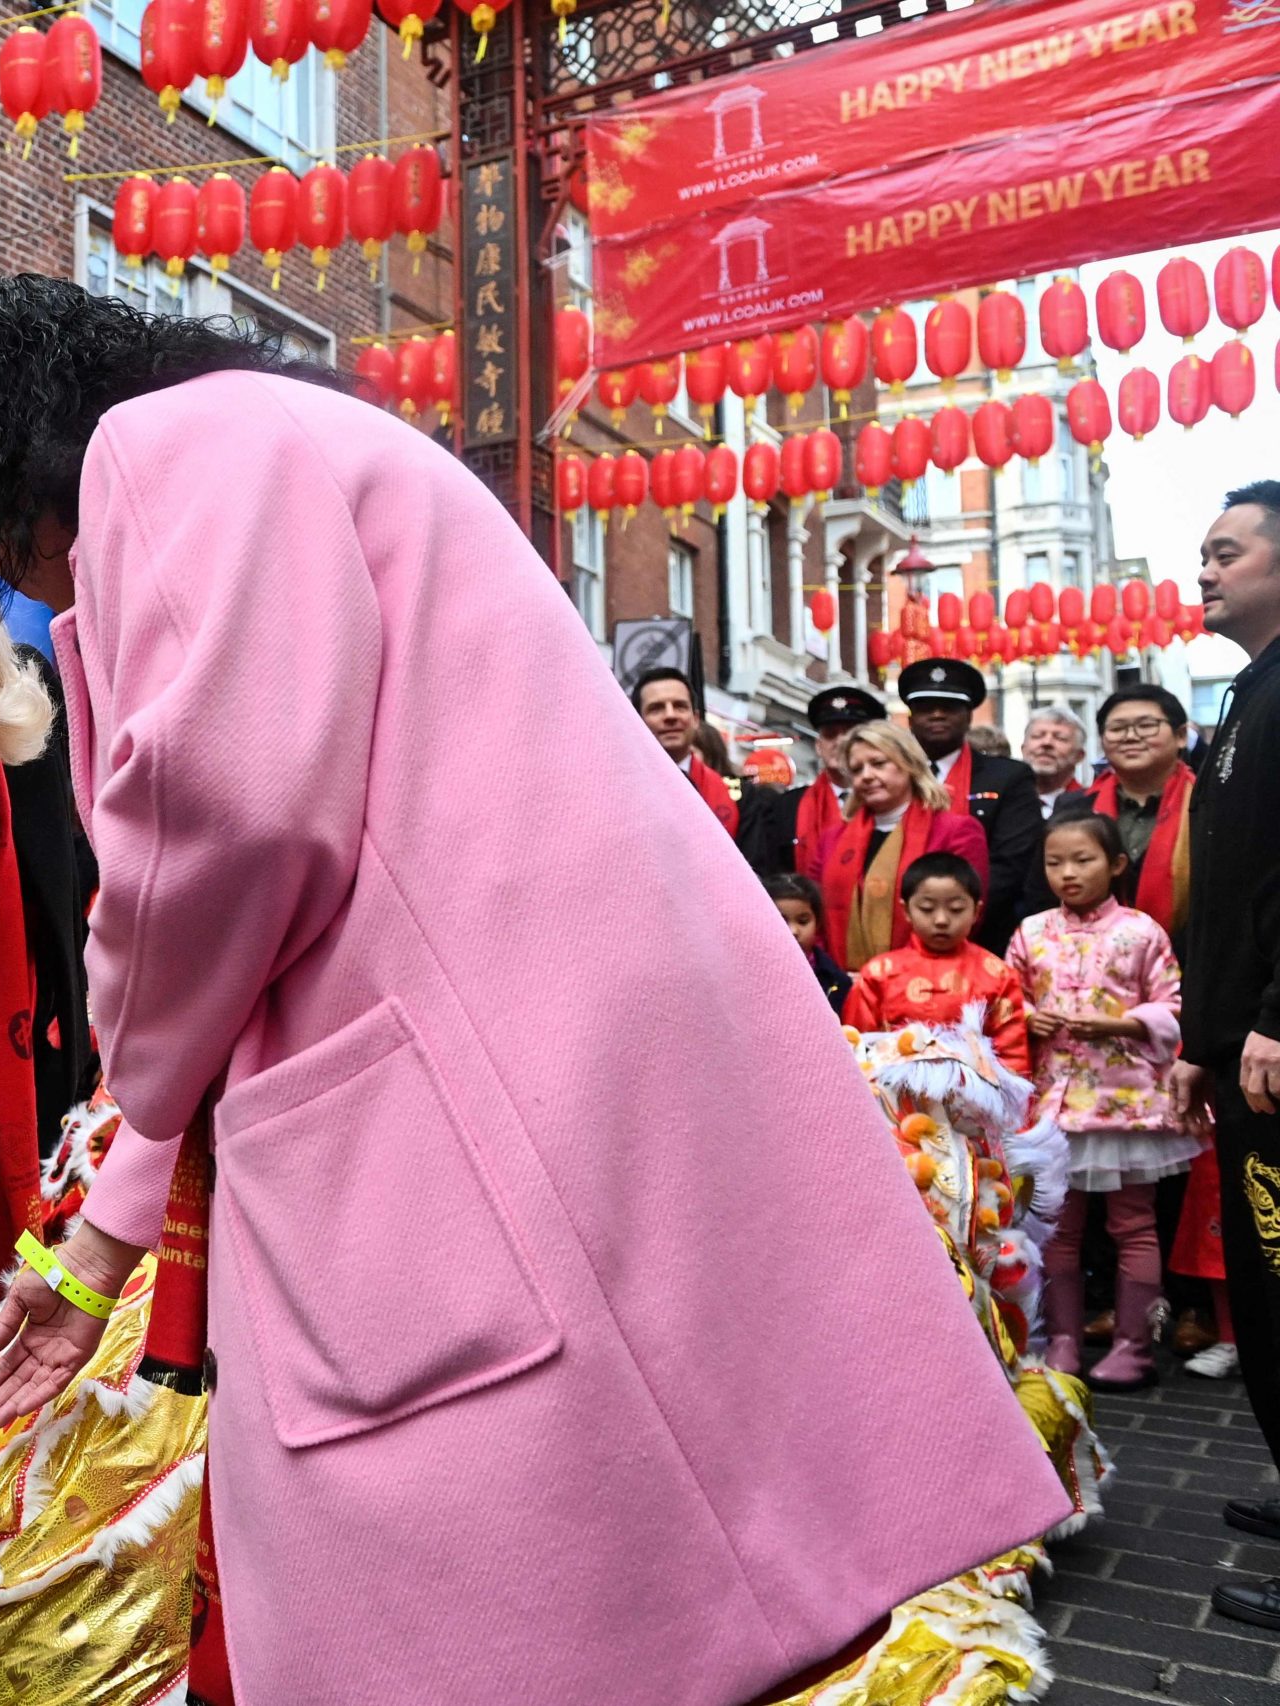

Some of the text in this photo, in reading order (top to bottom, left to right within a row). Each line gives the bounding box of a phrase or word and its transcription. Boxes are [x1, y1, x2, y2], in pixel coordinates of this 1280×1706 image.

[840, 1, 1198, 123] HAPPY NEW YEAR
[846, 148, 1211, 258] HAPPY NEW YEAR
